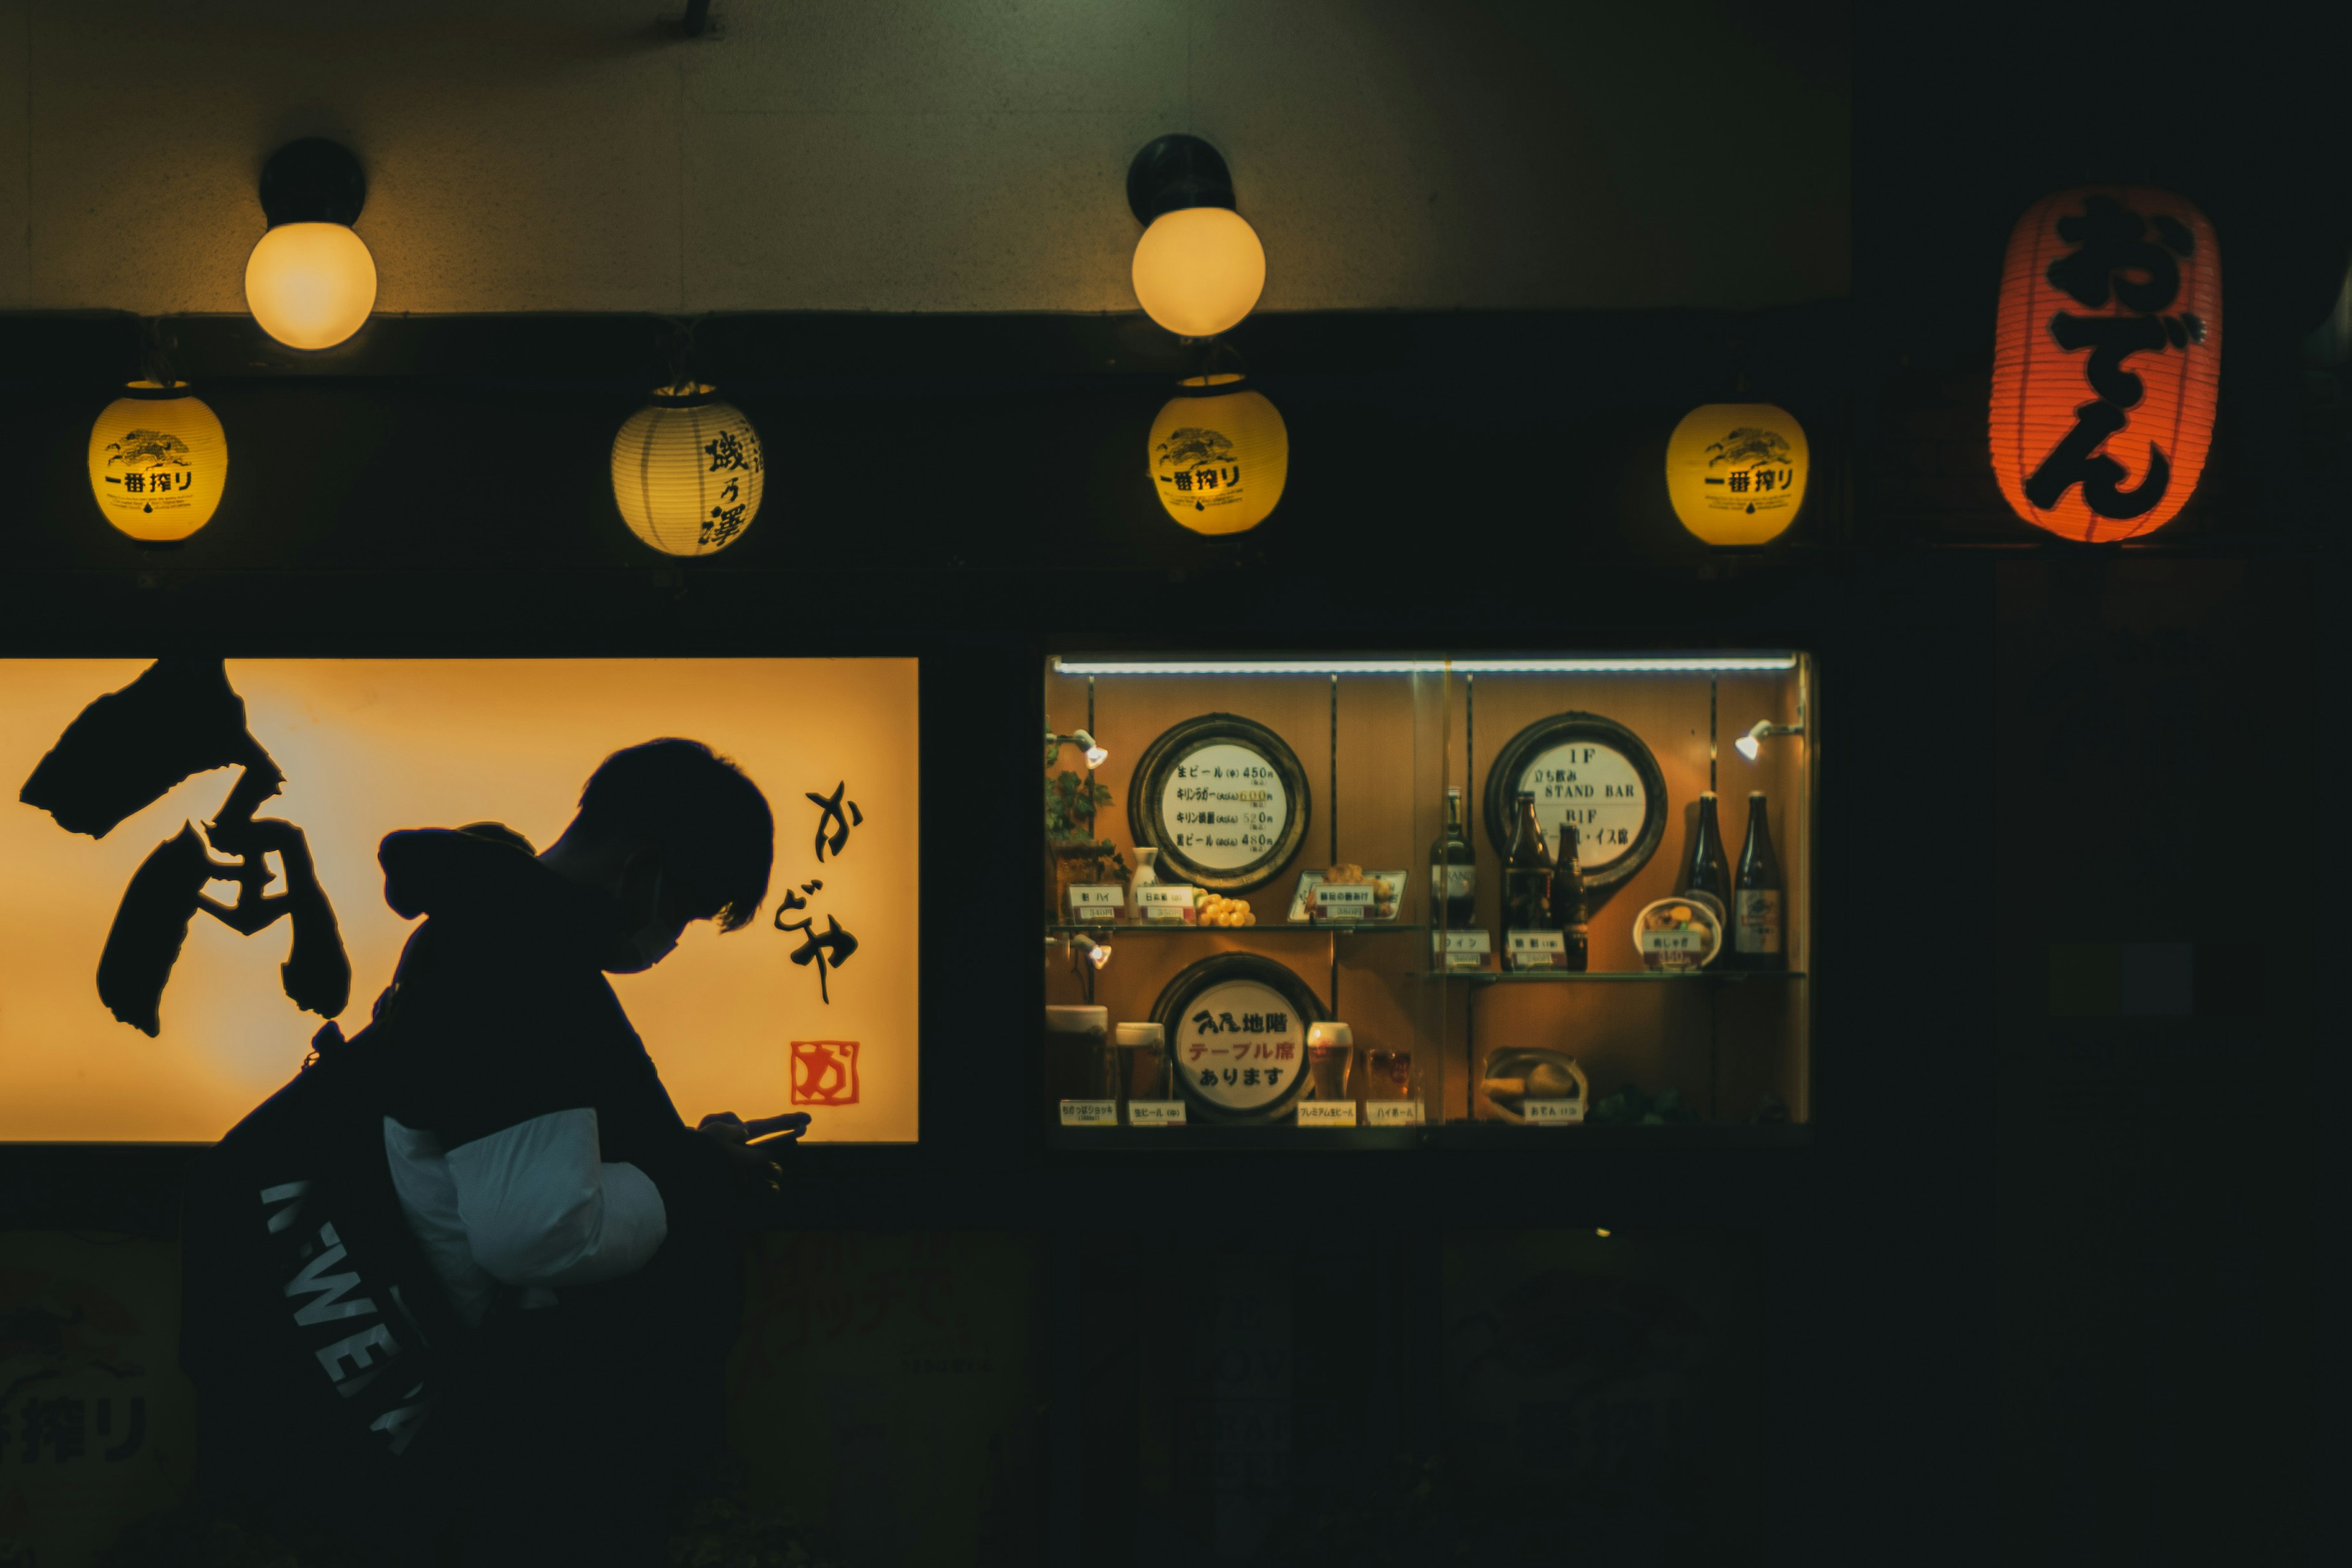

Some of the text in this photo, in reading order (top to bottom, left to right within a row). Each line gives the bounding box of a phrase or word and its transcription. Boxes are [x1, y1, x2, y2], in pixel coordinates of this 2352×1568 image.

[2026, 195, 2207, 519] おでん
[105, 472, 192, 492] 一番搾り
[1160, 466, 1239, 491] 一番搾り
[1705, 469, 1792, 492] 一番搾り
[1545, 785, 1634, 797] STAND BAR
[774, 780, 864, 1005] かどや
[1199, 1068, 1284, 1086] あります
